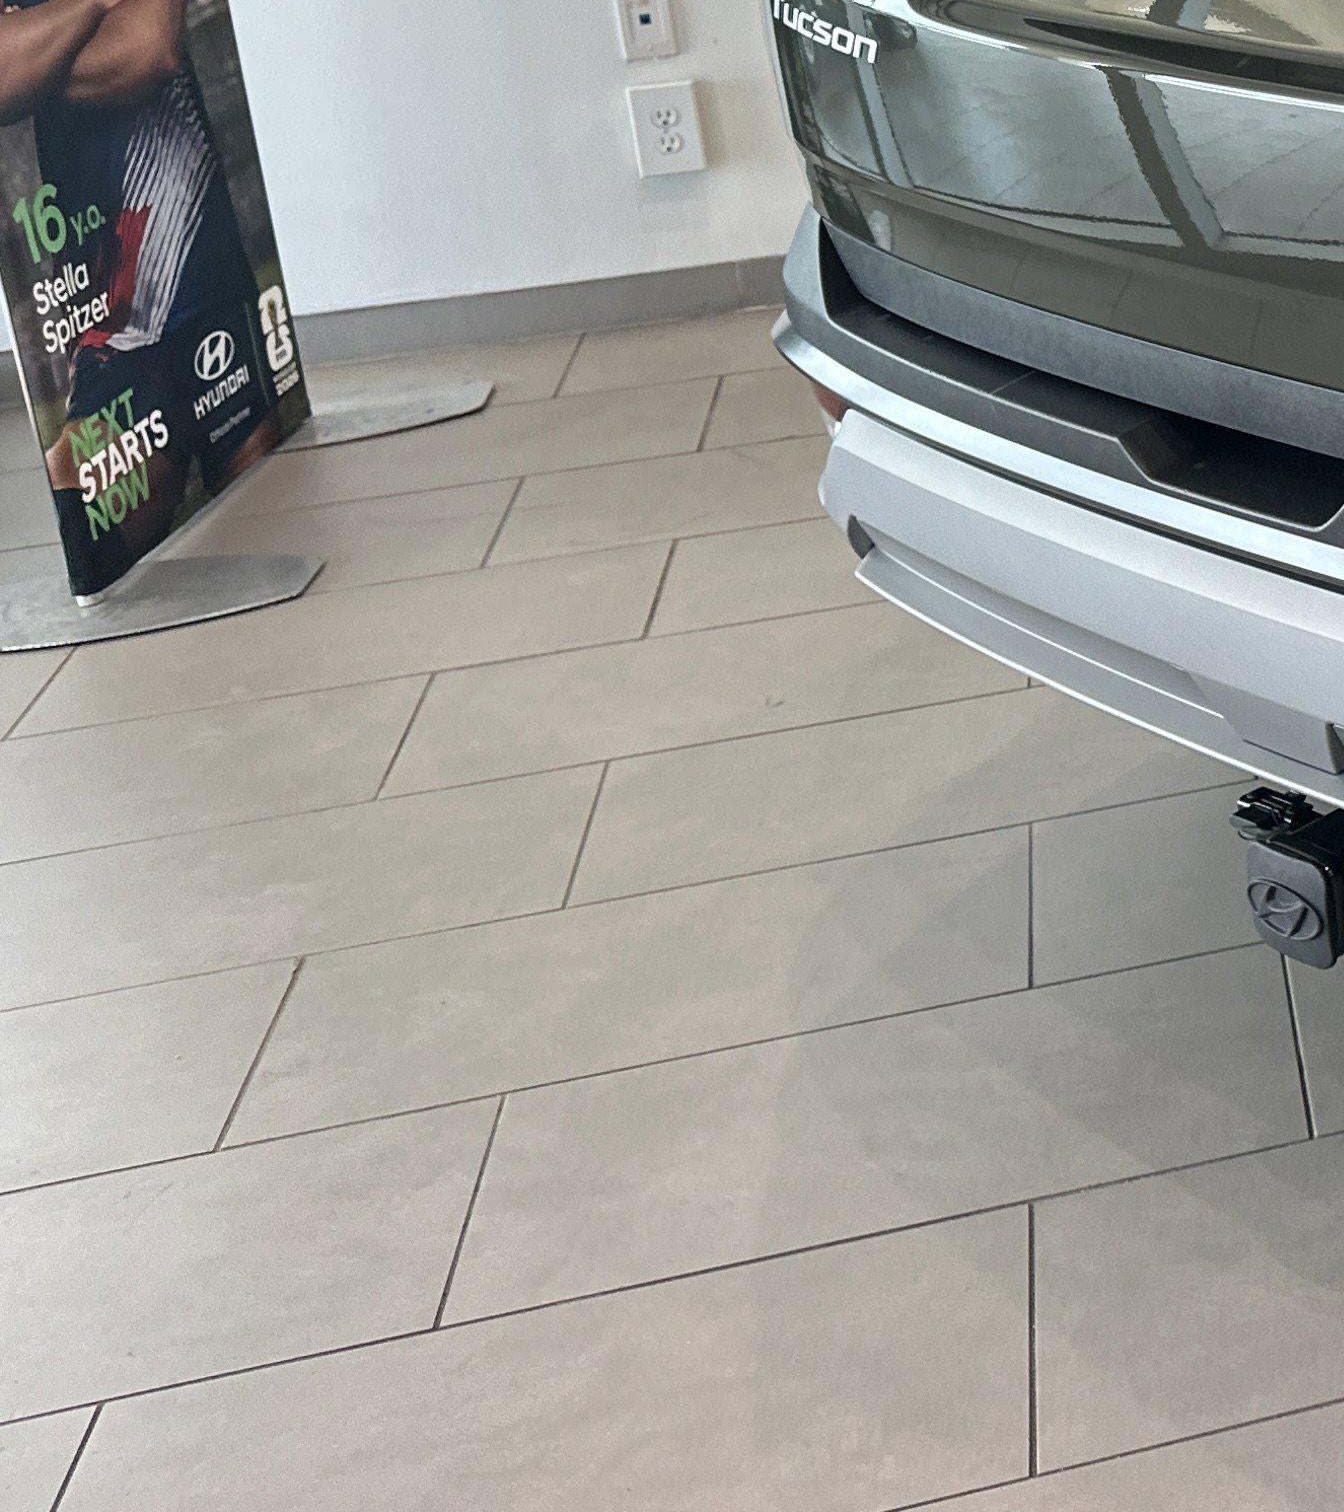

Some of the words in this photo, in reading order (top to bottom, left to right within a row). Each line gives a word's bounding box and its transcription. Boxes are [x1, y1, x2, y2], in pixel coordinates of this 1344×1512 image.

[12, 183, 67, 264] 16
[69, 204, 107, 246] y.o.
[32, 262, 90, 316] Stella
[42, 291, 111, 355] Spitzer
[67, 387, 135, 468] NEXT
[193, 364, 250, 421] HYUNDAI
[78, 409, 169, 494] STARTS
[84, 460, 150, 541] NOW
